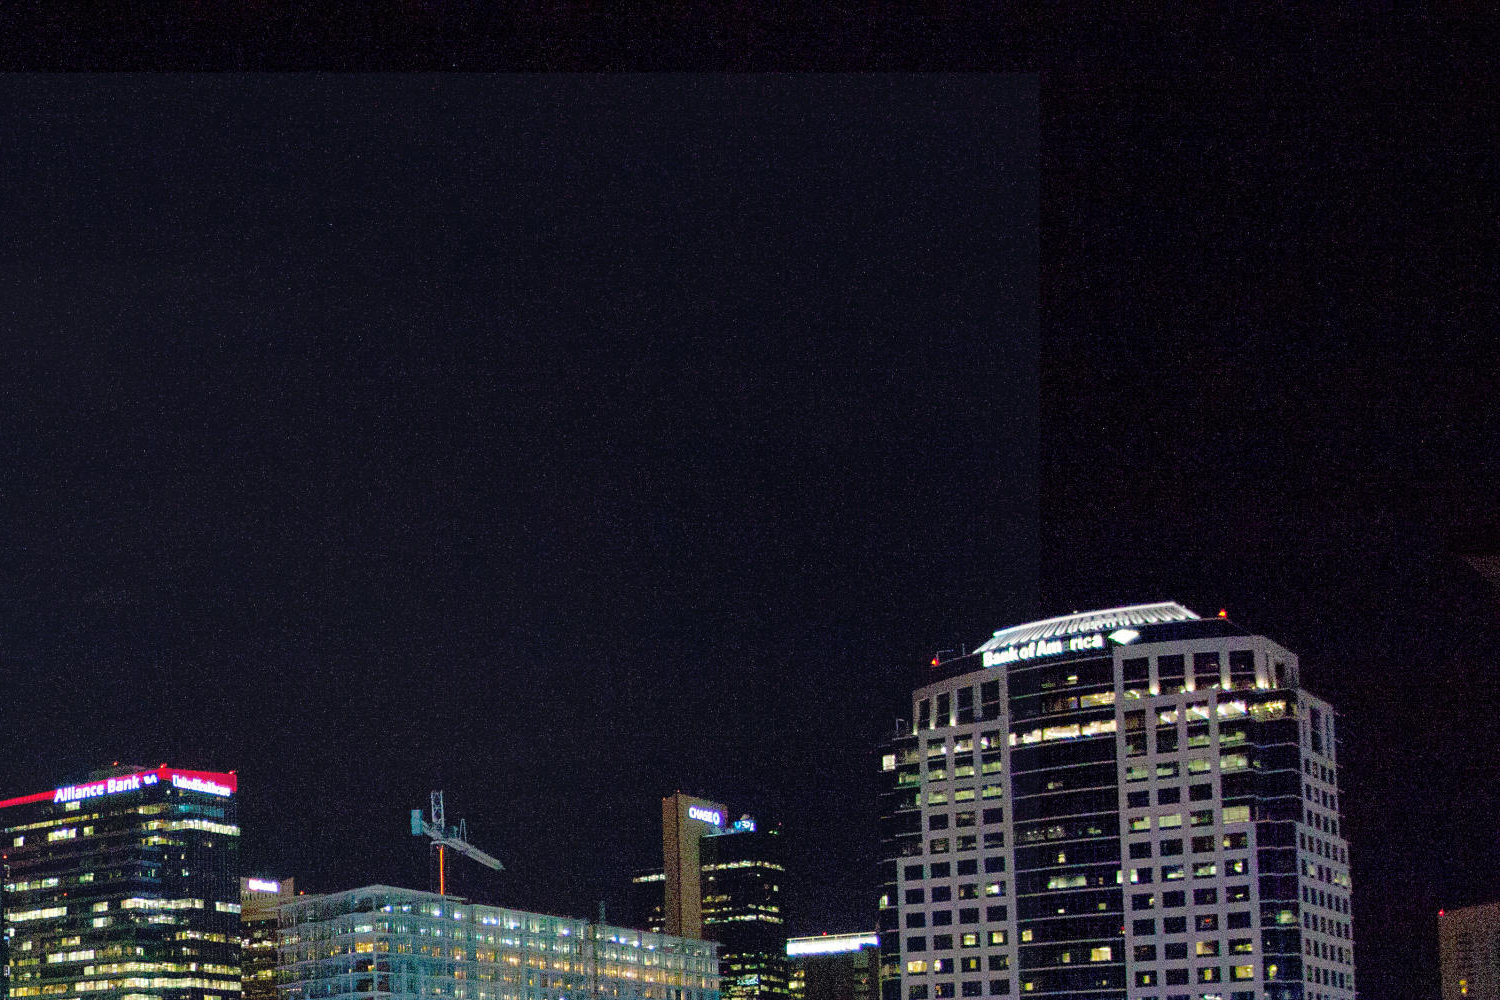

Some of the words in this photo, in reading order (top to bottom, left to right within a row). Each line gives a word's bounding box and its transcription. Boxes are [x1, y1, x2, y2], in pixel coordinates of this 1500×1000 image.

[982, 646, 1019, 668] Bank
[1019, 641, 1036, 660] of
[54, 784, 104, 803] Alliance
[107, 776, 140, 794] Bank
